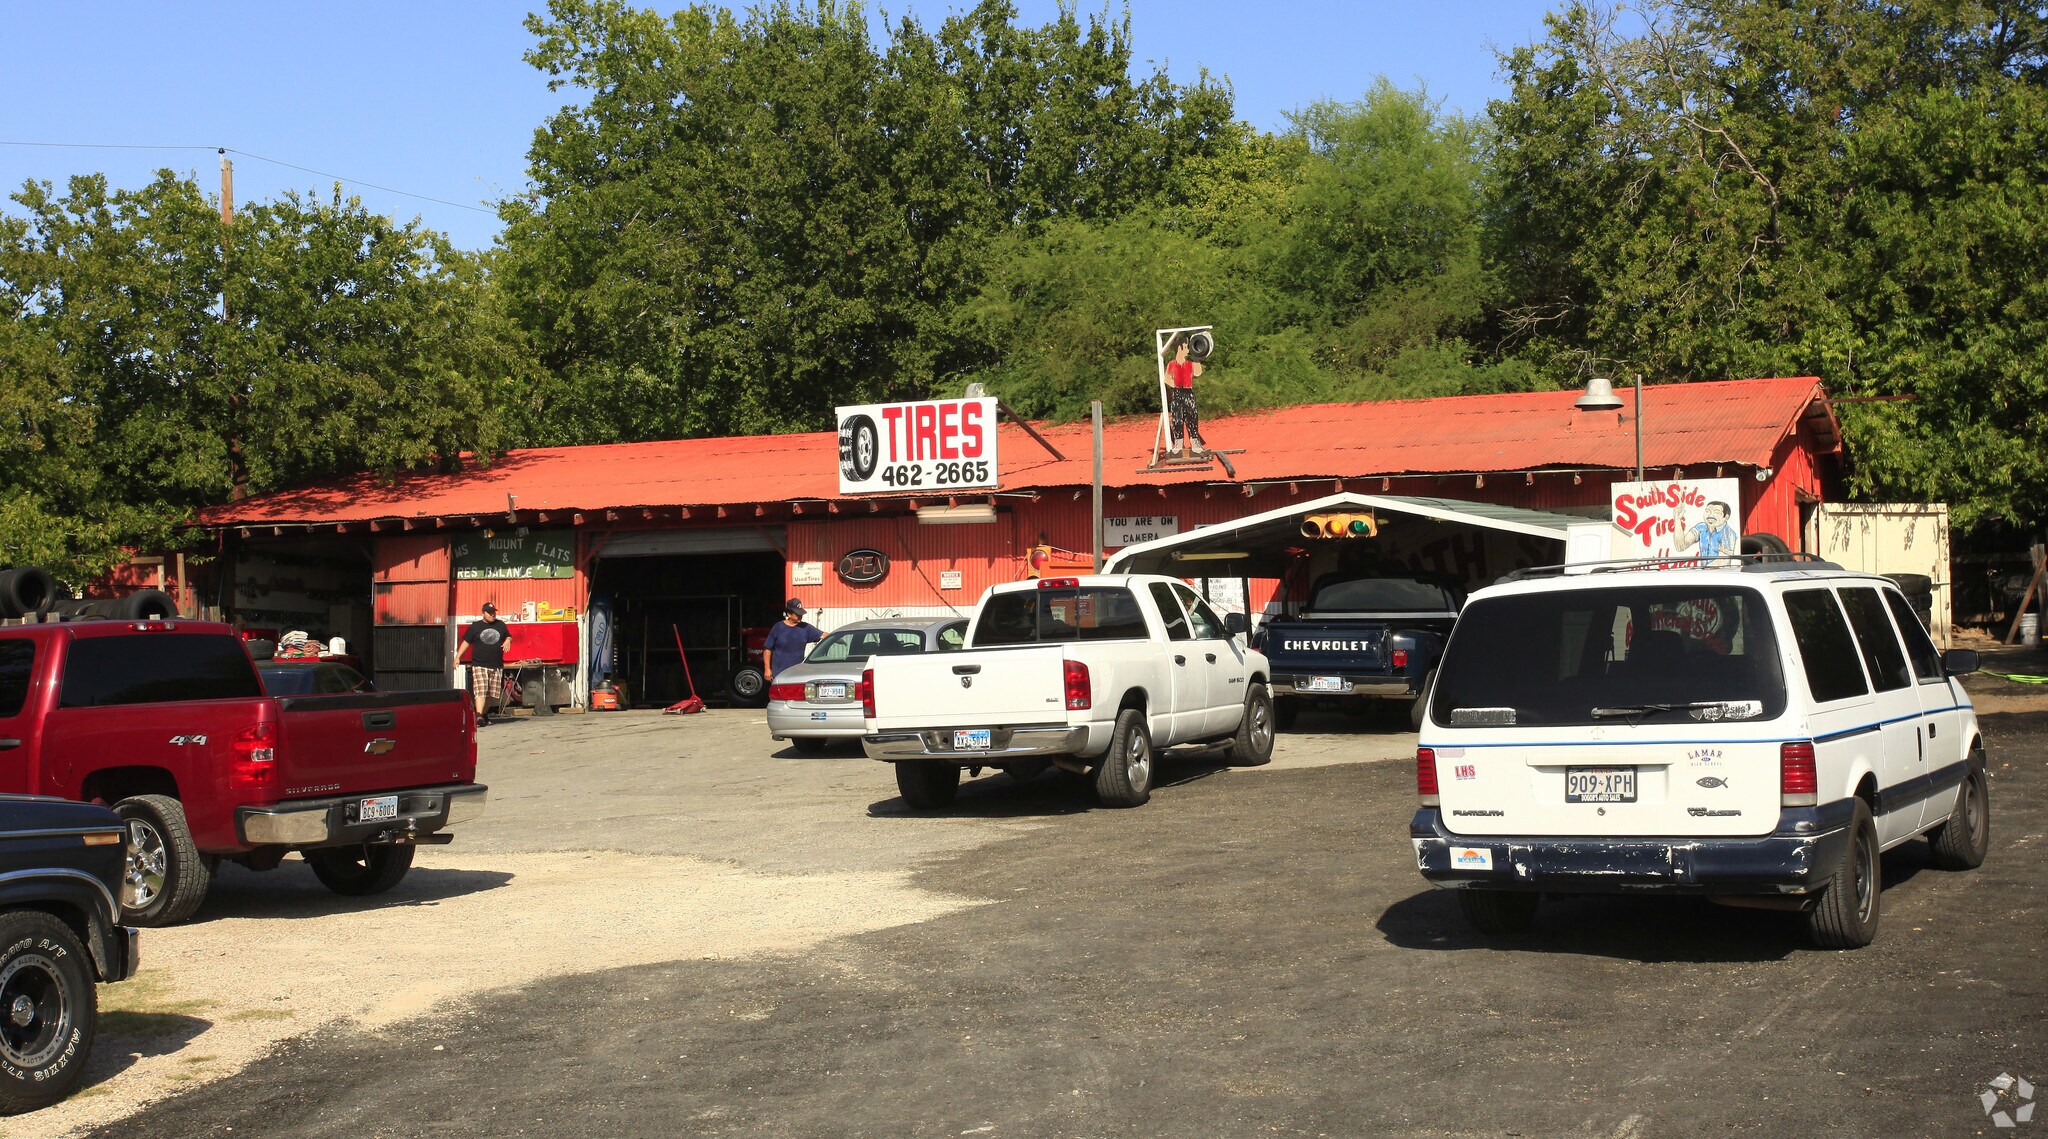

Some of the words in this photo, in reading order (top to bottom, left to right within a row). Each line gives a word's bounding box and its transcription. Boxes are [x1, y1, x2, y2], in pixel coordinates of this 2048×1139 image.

[882, 402, 983, 462] TIRES
[881, 460, 989, 487] 462-2665
[1110, 518, 1127, 527] YOU
[1135, 517, 1152, 526] ARE
[1161, 516, 1173, 526] ON
[1123, 533, 1159, 543] CAMERA
[488, 538, 524, 550] MOUNT
[535, 542, 571, 562] FLATS
[502, 552, 509, 563] &
[839, 555, 888, 576] OPEN
[1284, 640, 1369, 651] CHEVROLET
[1687, 749, 1723, 760] LAMAR
[1455, 765, 1476, 778] LHS
[285, 783, 340, 794] SILVERADO
[38, 938, 67, 958] A/T
[33, 1027, 82, 1082] MAXXIS
